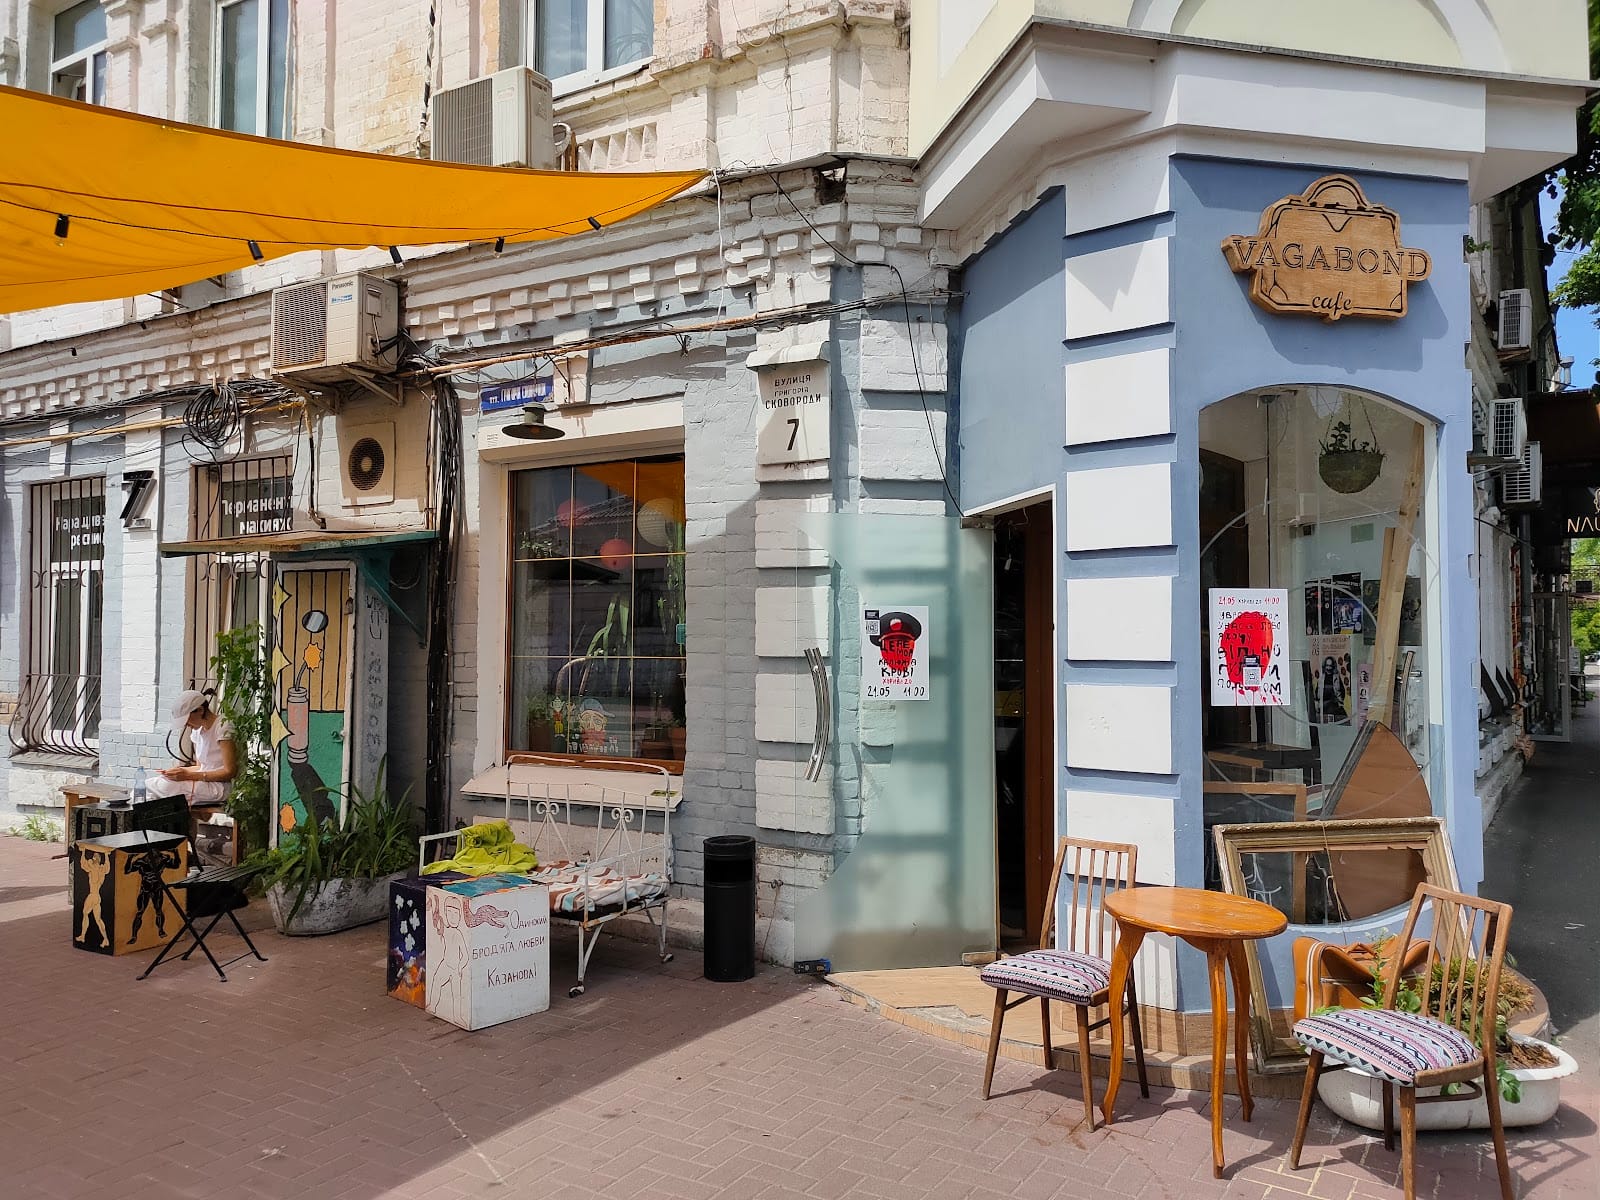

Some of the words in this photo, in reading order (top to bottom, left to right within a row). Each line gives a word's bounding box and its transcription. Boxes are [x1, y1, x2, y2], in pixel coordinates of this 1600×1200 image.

[1232, 239, 1427, 277] VAGABOND
[1312, 291, 1352, 316] cafe
[774, 374, 811, 387] ВУЛИЦЯ
[765, 393, 821, 410] СКОВОРОДИ
[787, 418, 800, 451] 7
